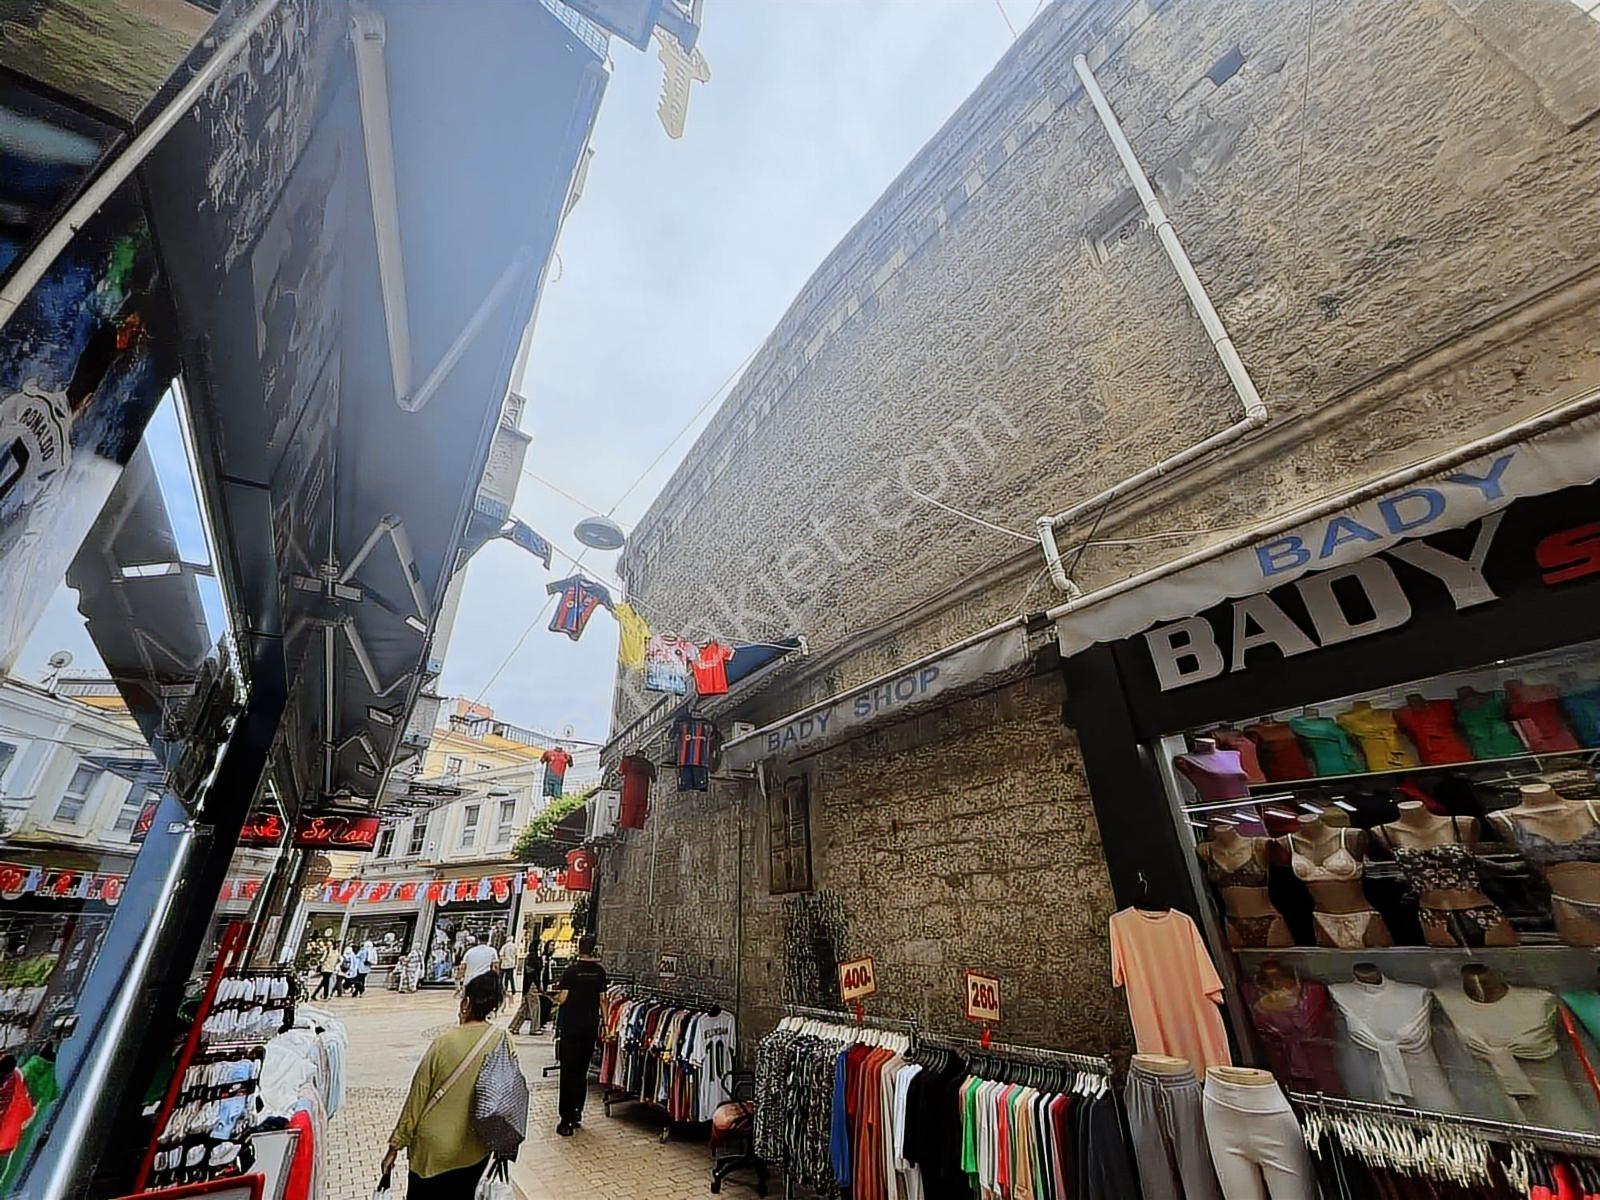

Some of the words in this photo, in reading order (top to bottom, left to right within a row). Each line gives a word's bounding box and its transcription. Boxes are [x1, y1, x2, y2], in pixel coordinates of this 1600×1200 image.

[19, 407, 55, 462] RONALDO
[1256, 452, 1516, 577] BADY
[1144, 510, 1508, 692] BADY
[767, 705, 833, 753] BADY
[853, 666, 941, 718] SHOP
